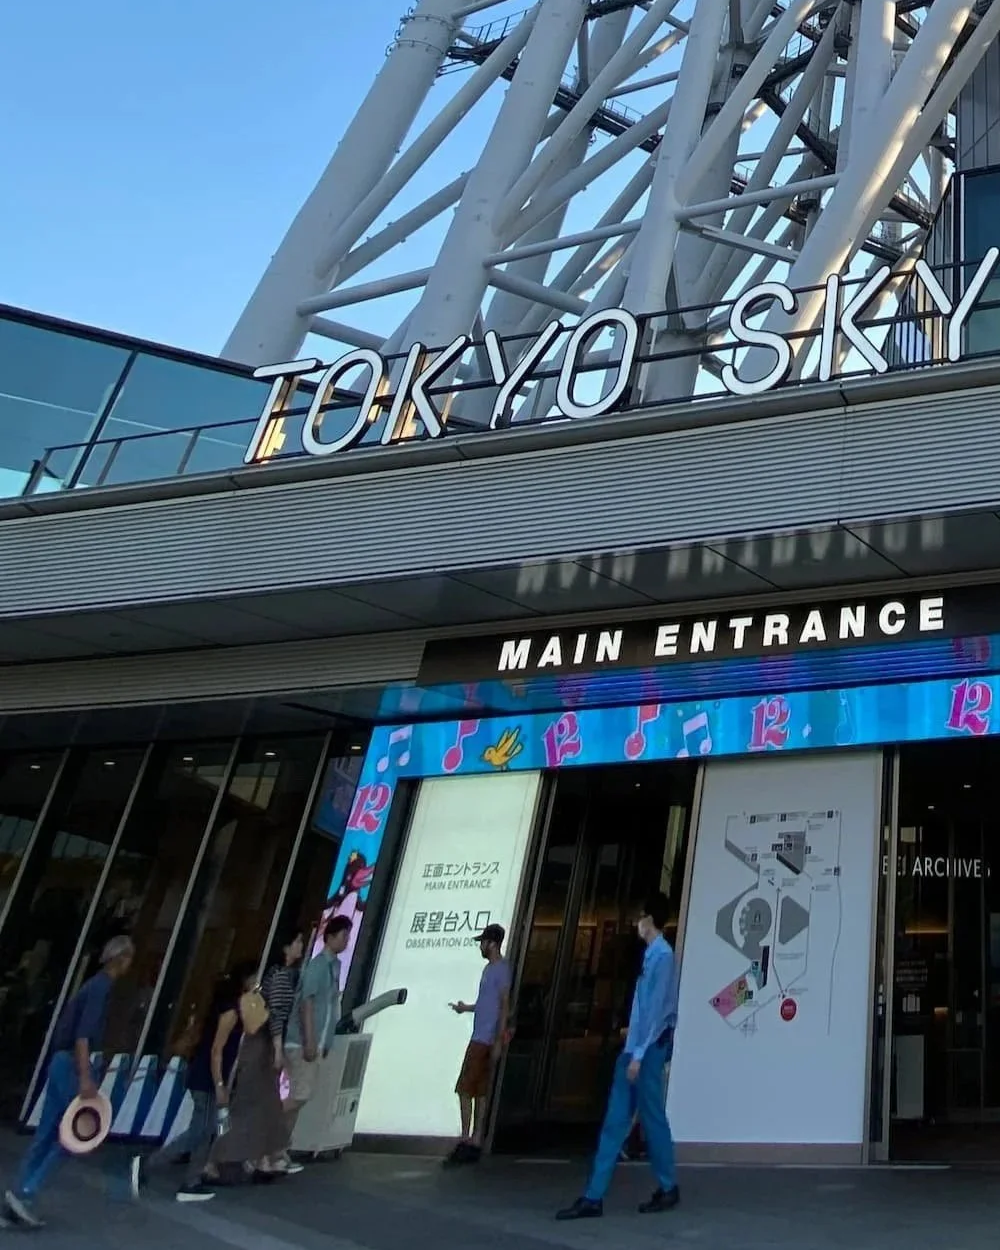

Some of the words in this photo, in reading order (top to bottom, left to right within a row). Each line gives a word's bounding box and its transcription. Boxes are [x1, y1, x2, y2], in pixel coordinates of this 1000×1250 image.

[243, 308, 638, 464] TOKYO
[498, 630, 623, 671] MAIN
[654, 597, 944, 657] ENTRANCE
[748, 695, 791, 751] 12
[944, 678, 992, 736] 12
[542, 711, 582, 767] 12
[346, 782, 391, 834] 12
[422, 862, 500, 878] 正面エントランス
[424, 880, 446, 891] MAIN
[447, 878, 492, 890] ENTRANCE
[405, 936, 460, 950] OBSERVATION
[462, 936, 480, 948] DEC
[409, 911, 491, 933] 展望台入口
